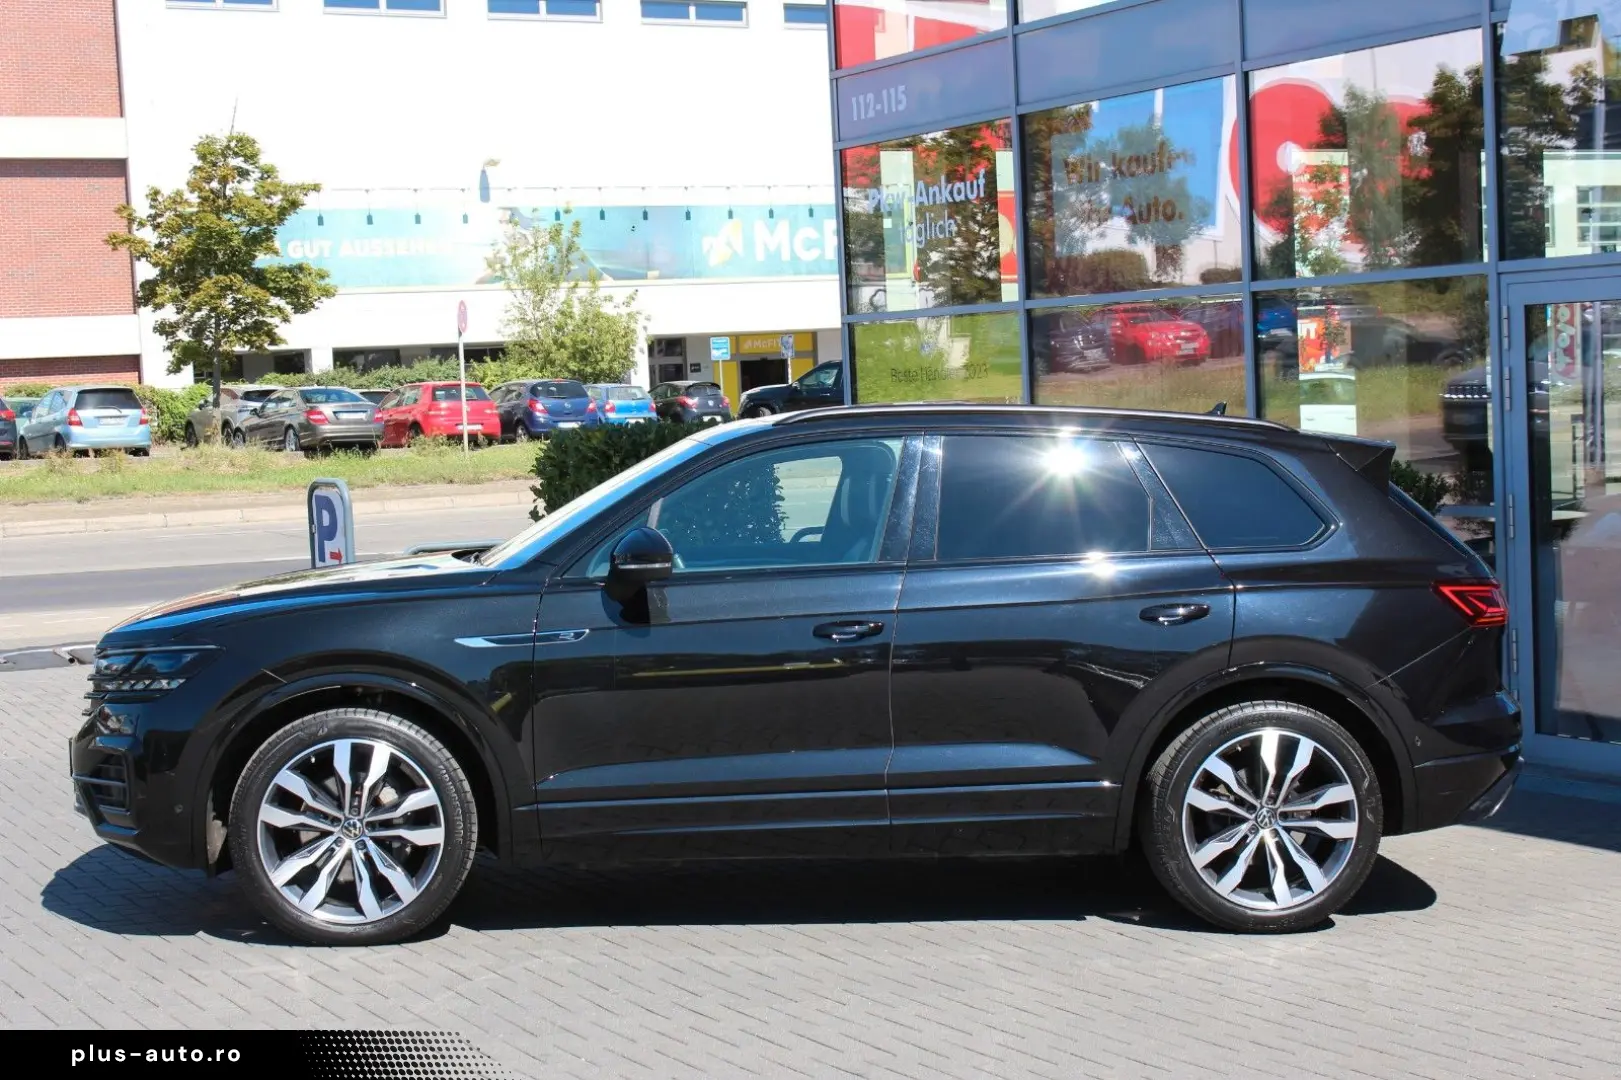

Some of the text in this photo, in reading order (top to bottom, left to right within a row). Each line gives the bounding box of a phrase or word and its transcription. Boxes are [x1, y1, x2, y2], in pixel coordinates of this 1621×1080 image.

[851, 85, 907, 121] 112-115
[1121, 194, 1185, 225] Auto.
[287, 238, 334, 259] GUT
[314, 495, 338, 563] P
